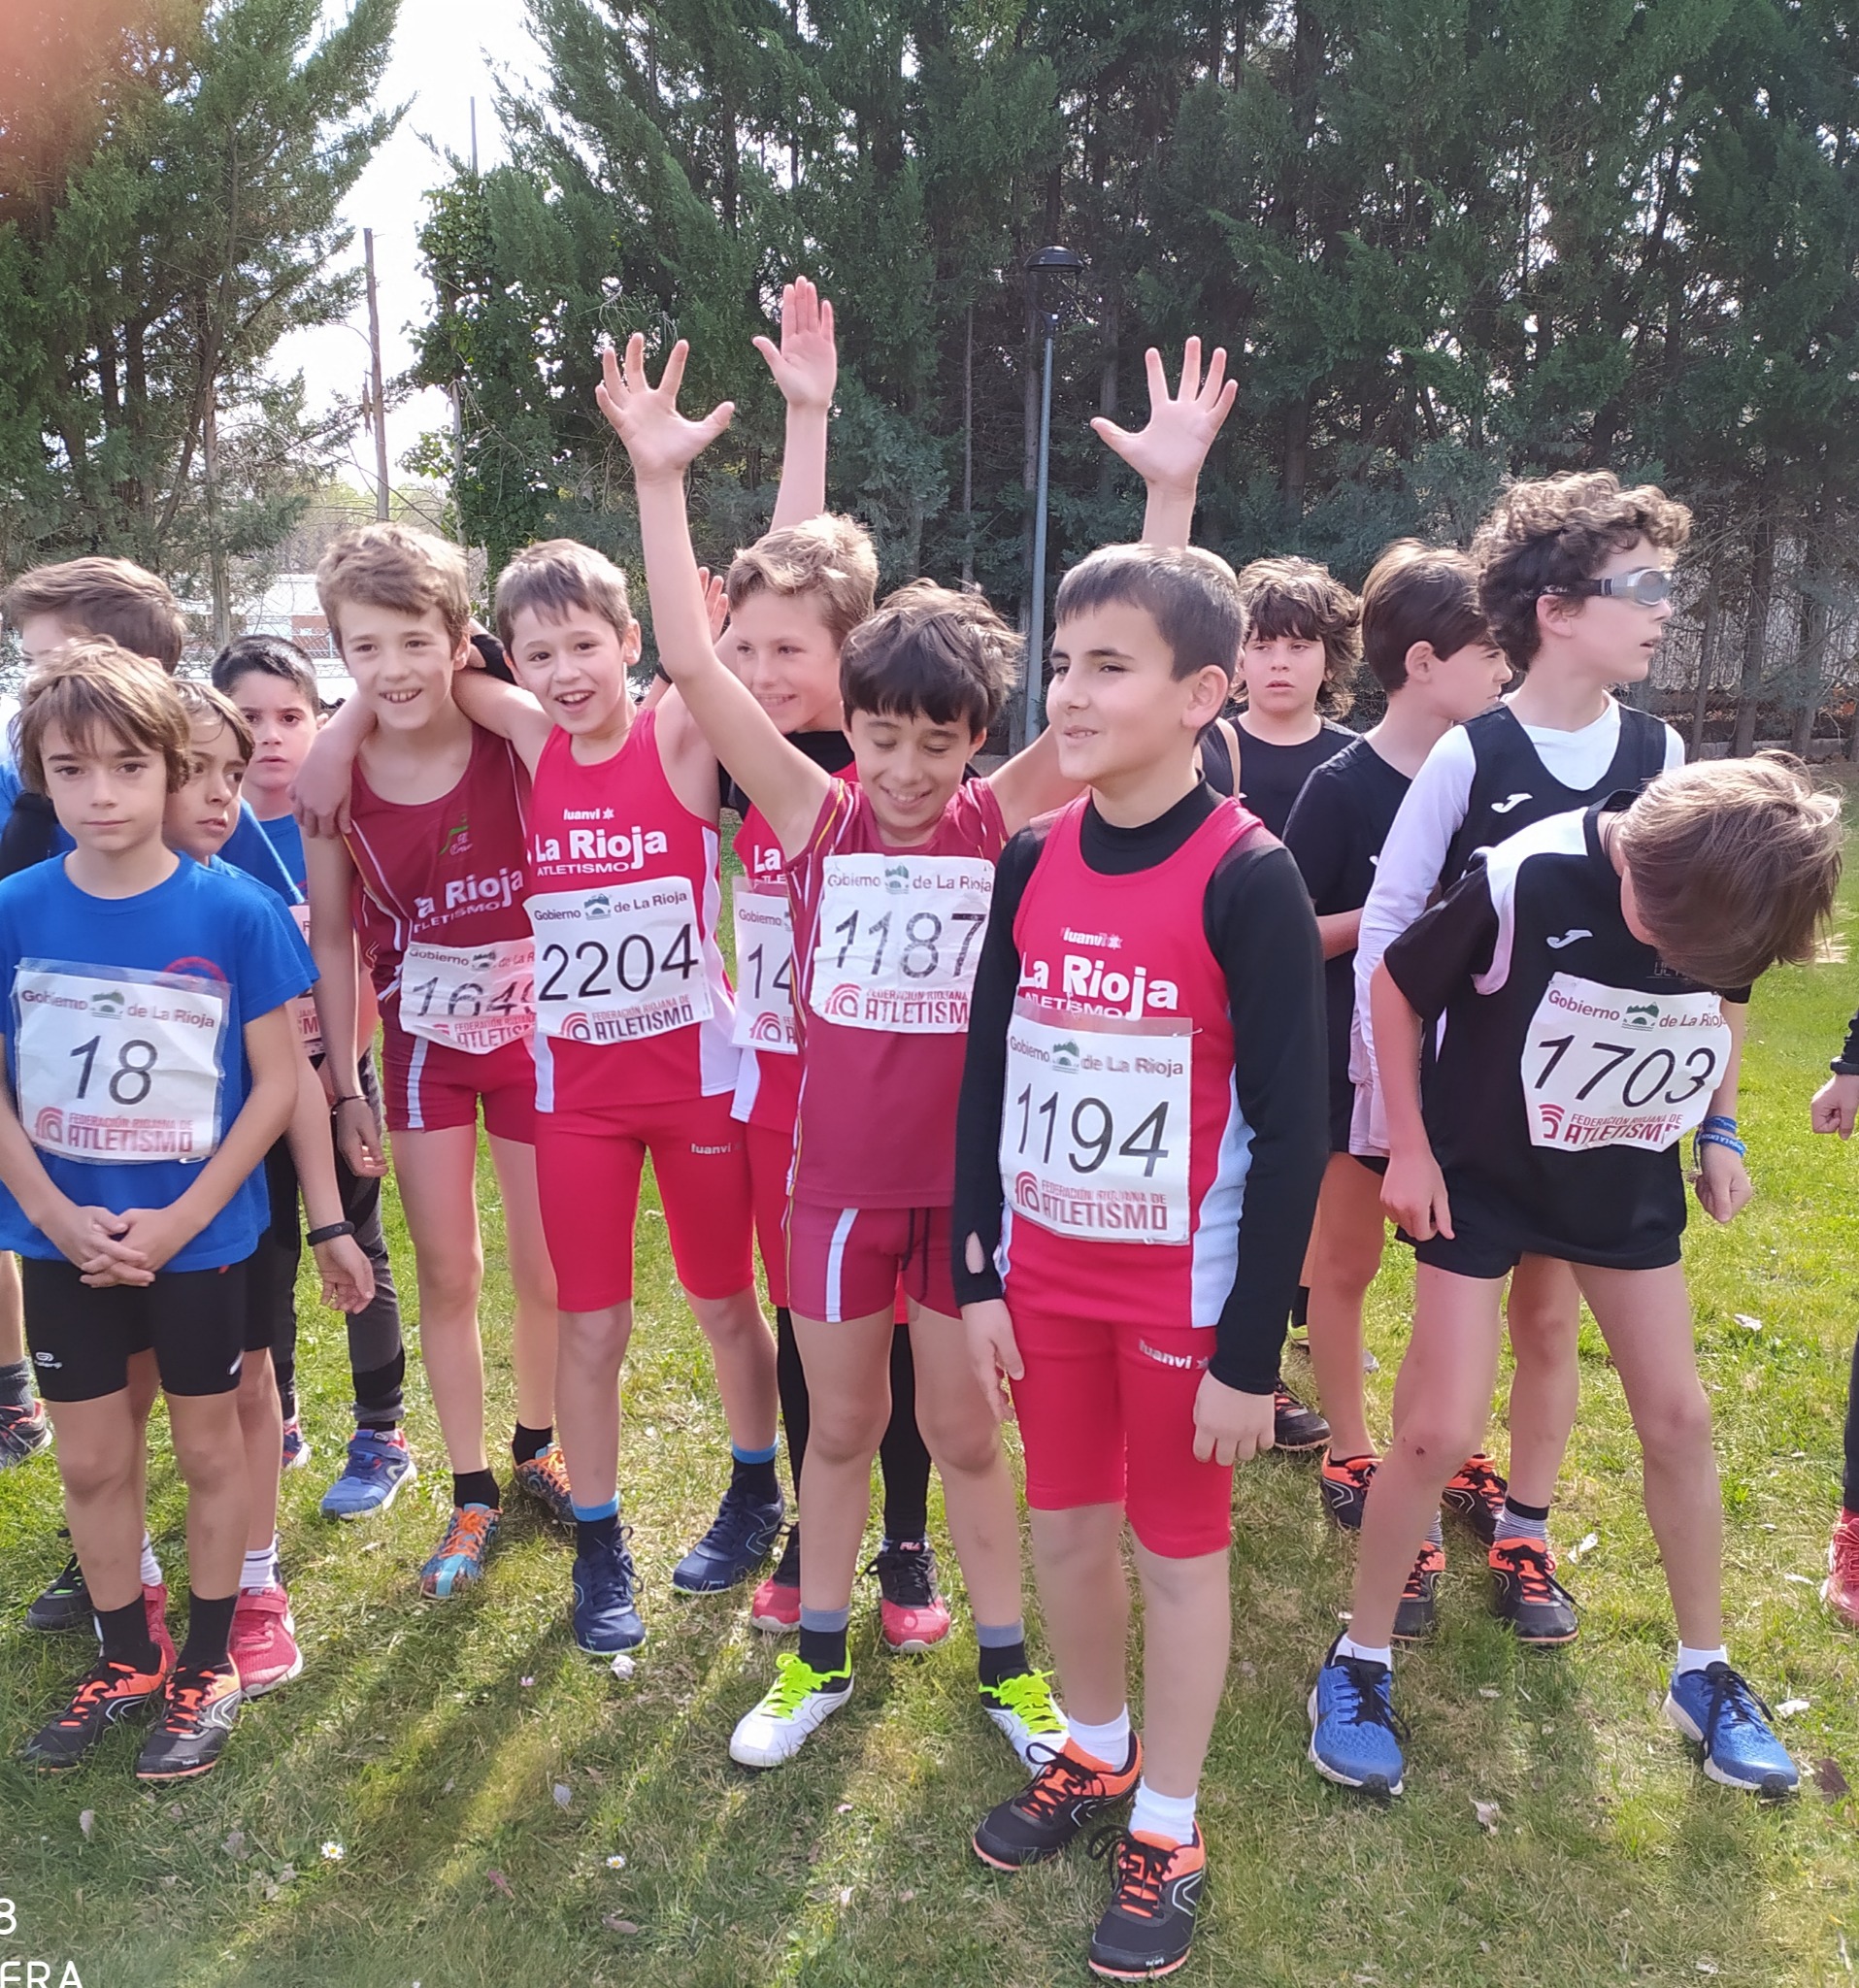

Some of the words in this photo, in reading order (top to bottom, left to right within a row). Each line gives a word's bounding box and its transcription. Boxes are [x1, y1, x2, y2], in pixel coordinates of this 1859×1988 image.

[563, 808, 601, 821] luanvi
[535, 834, 560, 862] La
[569, 825, 668, 870] Rioja
[753, 845, 781, 874] La
[537, 861, 630, 877] ATLETISMO
[827, 874, 880, 887] Gobierno
[913, 876, 932, 889] de
[937, 875, 954, 889] La
[959, 876, 992, 893] Rioja
[414, 897, 435, 919] a
[446, 867, 523, 910] Rioja
[534, 909, 581, 921] Gobierno
[614, 902, 631, 913] de
[633, 899, 649, 911] La
[651, 891, 687, 908] Rioja
[414, 901, 500, 934] TLETISMO
[739, 909, 782, 926] Gobierno
[409, 948, 470, 967] Gobierno
[835, 910, 987, 978] 1187
[538, 923, 699, 1002] 2204
[1019, 951, 1049, 989] La
[1062, 954, 1178, 1021] Rioja
[21, 989, 88, 1011] Gobierno
[127, 1003, 147, 1017] de
[152, 1005, 169, 1020] La
[175, 1009, 216, 1028] Rioja
[594, 1004, 694, 1041] ATLETISMO
[1024, 992, 1123, 1018] ATLETISMO
[1548, 989, 1620, 1021] Gobierno
[1659, 1013, 1677, 1028] de
[1679, 1013, 1698, 1027] La
[70, 1035, 158, 1106] 18
[1010, 1036, 1050, 1063] Gobierno
[1080, 1055, 1103, 1071] de
[1107, 1055, 1130, 1073] La
[1135, 1057, 1183, 1077] Rioja
[1534, 1034, 1716, 1108] 1703
[1017, 1083, 1169, 1177] 1194
[1571, 1113, 1629, 1126] FEDERACIÓN
[1669, 1113, 1683, 1124] DE
[68, 1124, 193, 1152] ATLETISMO
[690, 1143, 731, 1155] luanvi
[1042, 1193, 1168, 1230] ATLETISMO
[1139, 1339, 1192, 1370] luanvi
